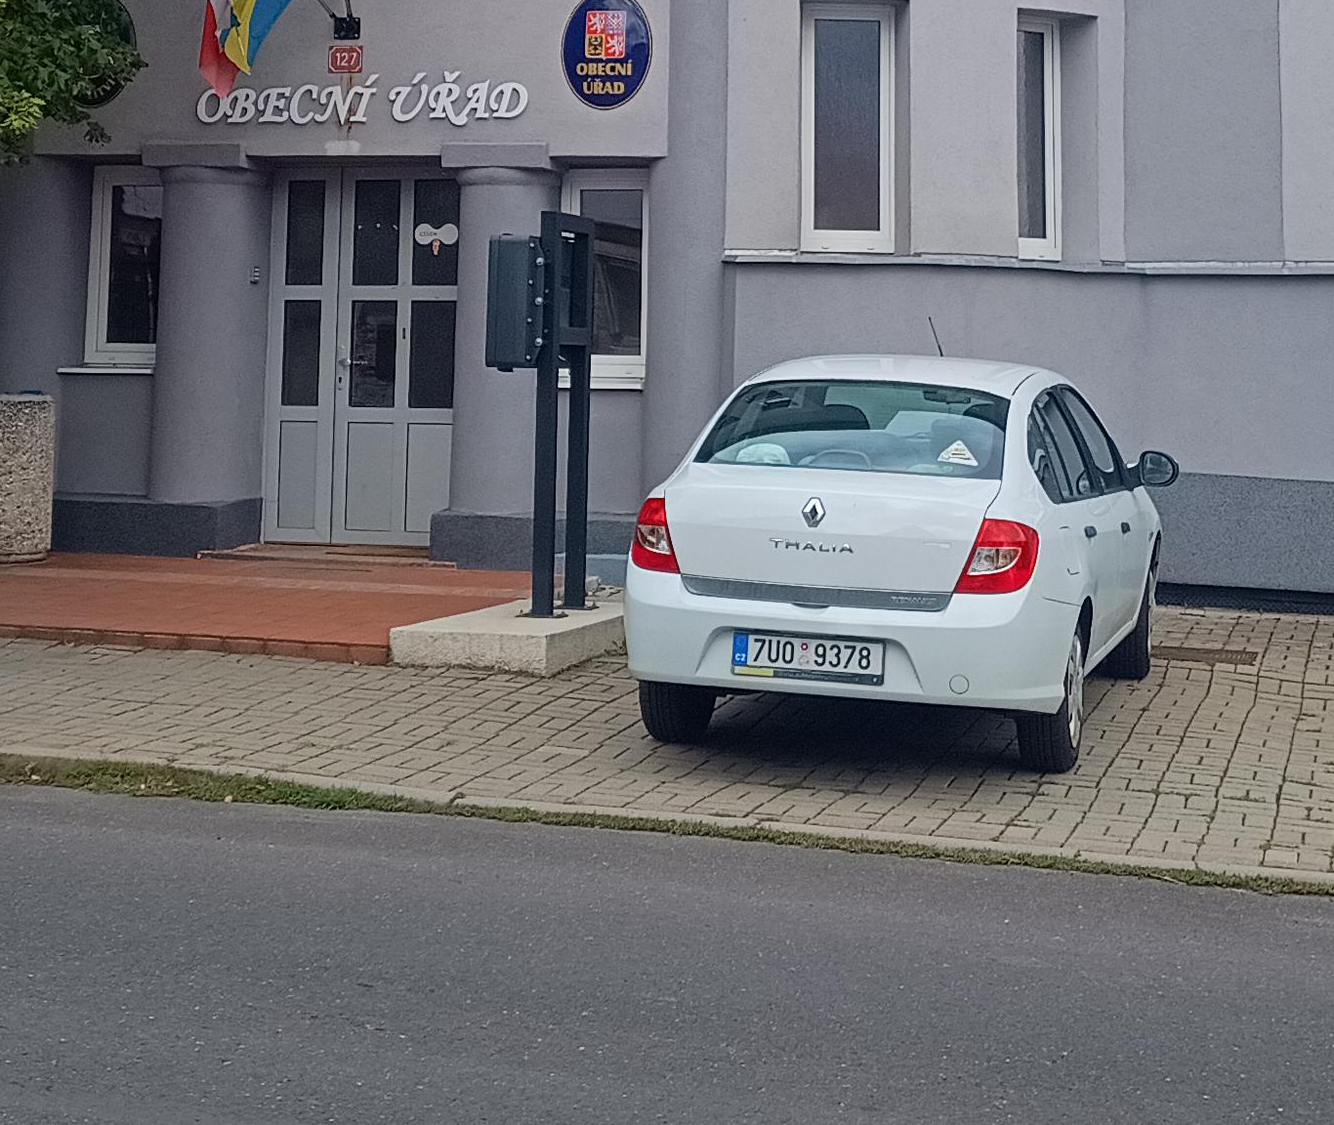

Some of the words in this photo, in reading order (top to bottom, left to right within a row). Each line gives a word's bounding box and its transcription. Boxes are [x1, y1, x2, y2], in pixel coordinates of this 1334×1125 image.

[335, 52, 358, 67] 127
[576, 59, 633, 76] OBECNÍ
[582, 78, 625, 95] ÚŘAD
[196, 74, 380, 126] OBECNÍ
[388, 70, 529, 126] ÚŘAD
[769, 537, 854, 554] THALIA
[734, 652, 747, 662] CZ
[752, 638, 795, 665] 7U0
[813, 642, 872, 671] 9378
